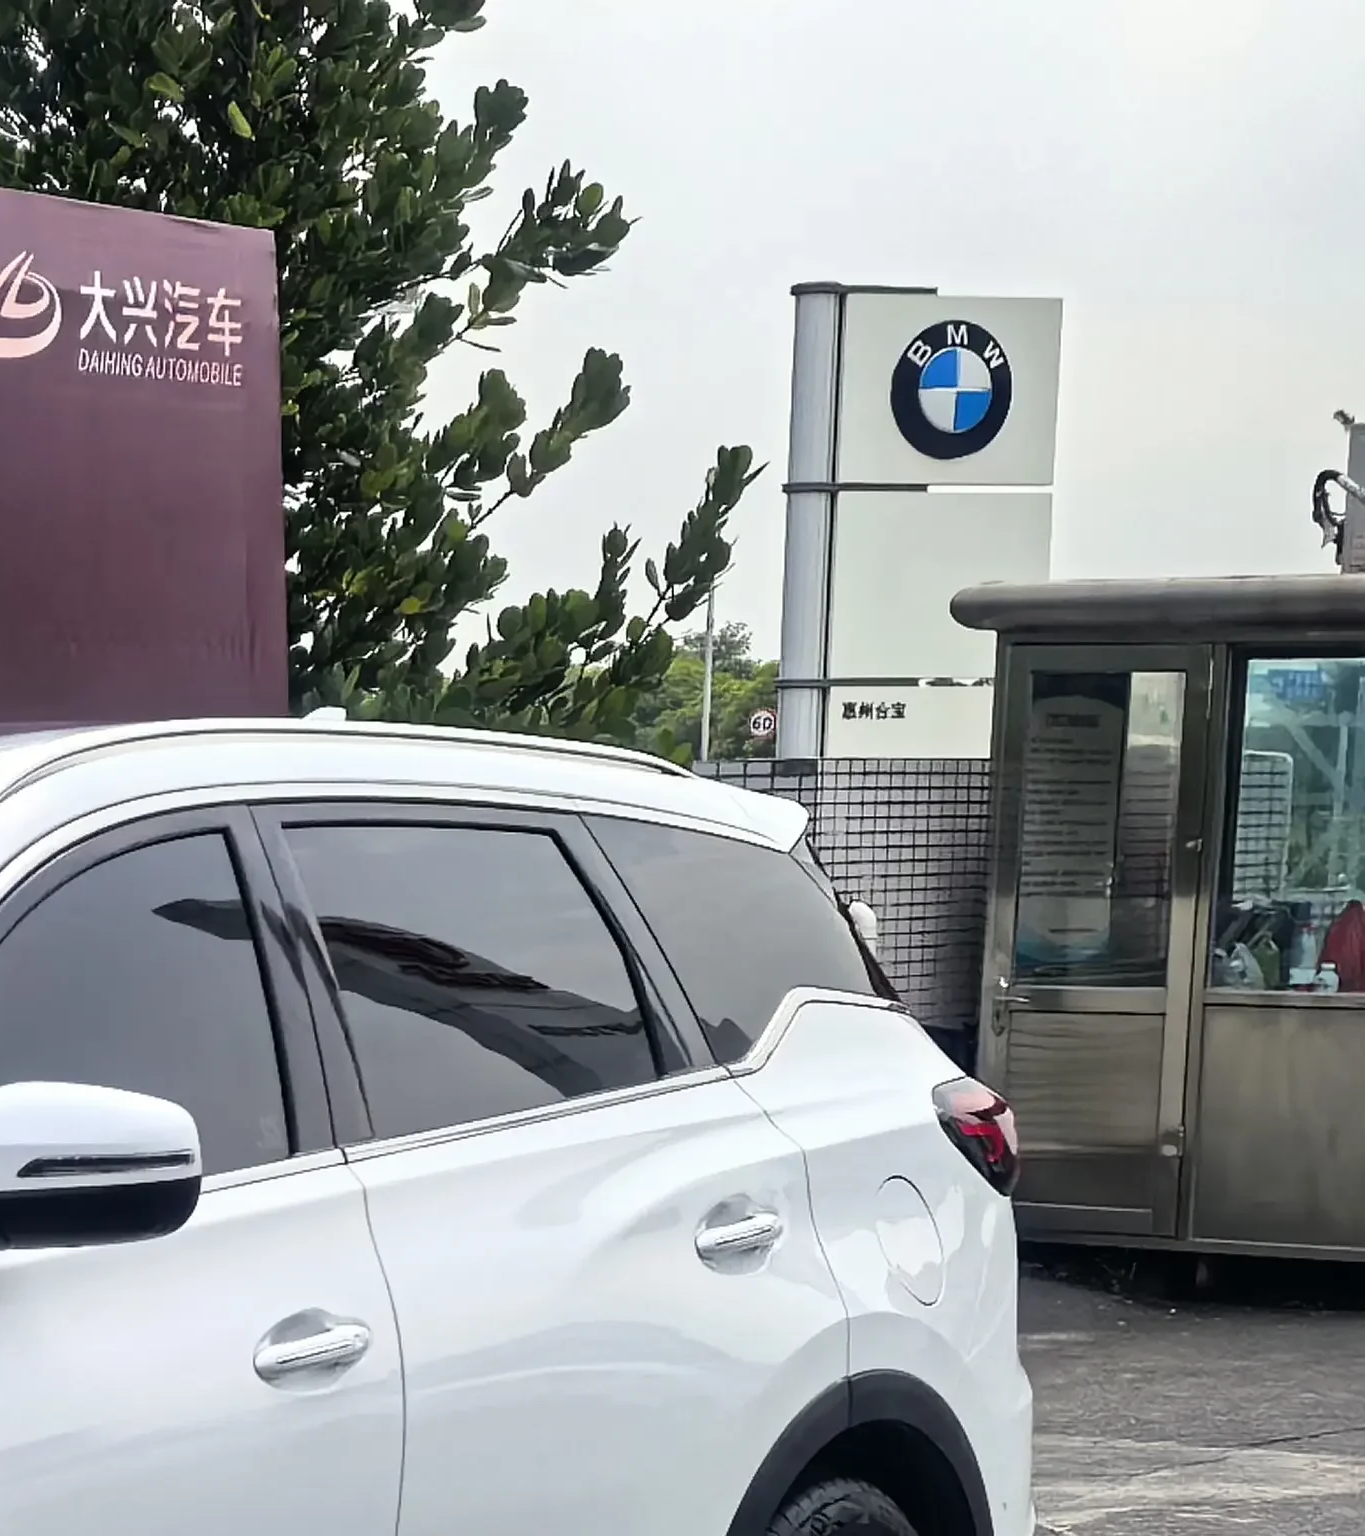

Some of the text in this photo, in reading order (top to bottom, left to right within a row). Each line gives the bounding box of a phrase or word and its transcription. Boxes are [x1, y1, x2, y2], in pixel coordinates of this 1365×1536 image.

[79, 270, 243, 356] 大兴汽车
[78, 348, 243, 387] DAIHING AUTOMOBILE
[907, 324, 1004, 369] BMW
